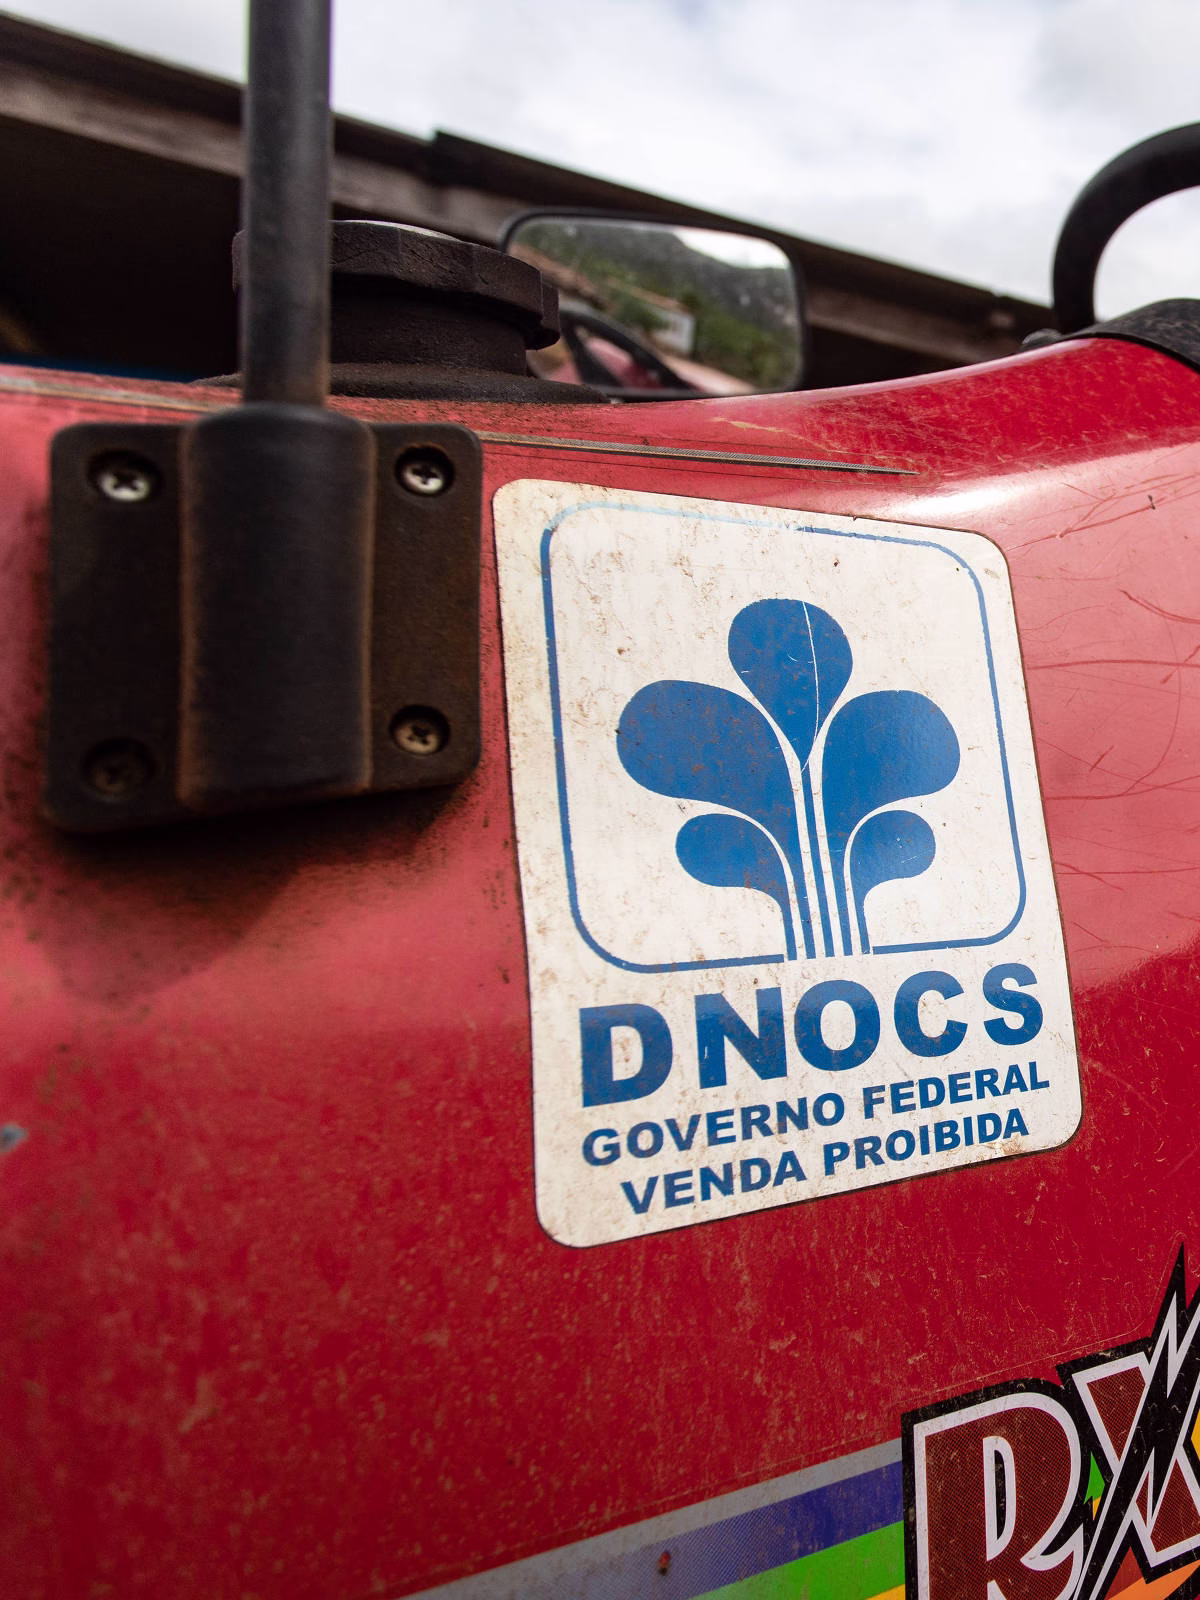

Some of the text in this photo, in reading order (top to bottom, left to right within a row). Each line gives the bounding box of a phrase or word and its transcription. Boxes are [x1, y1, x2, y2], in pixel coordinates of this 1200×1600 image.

[579, 962, 1044, 1109] DNOCS
[581, 1061, 1051, 1167] GOVERNO FEDERAL
[621, 1107, 1029, 1215] VENDA PROIBIDA
